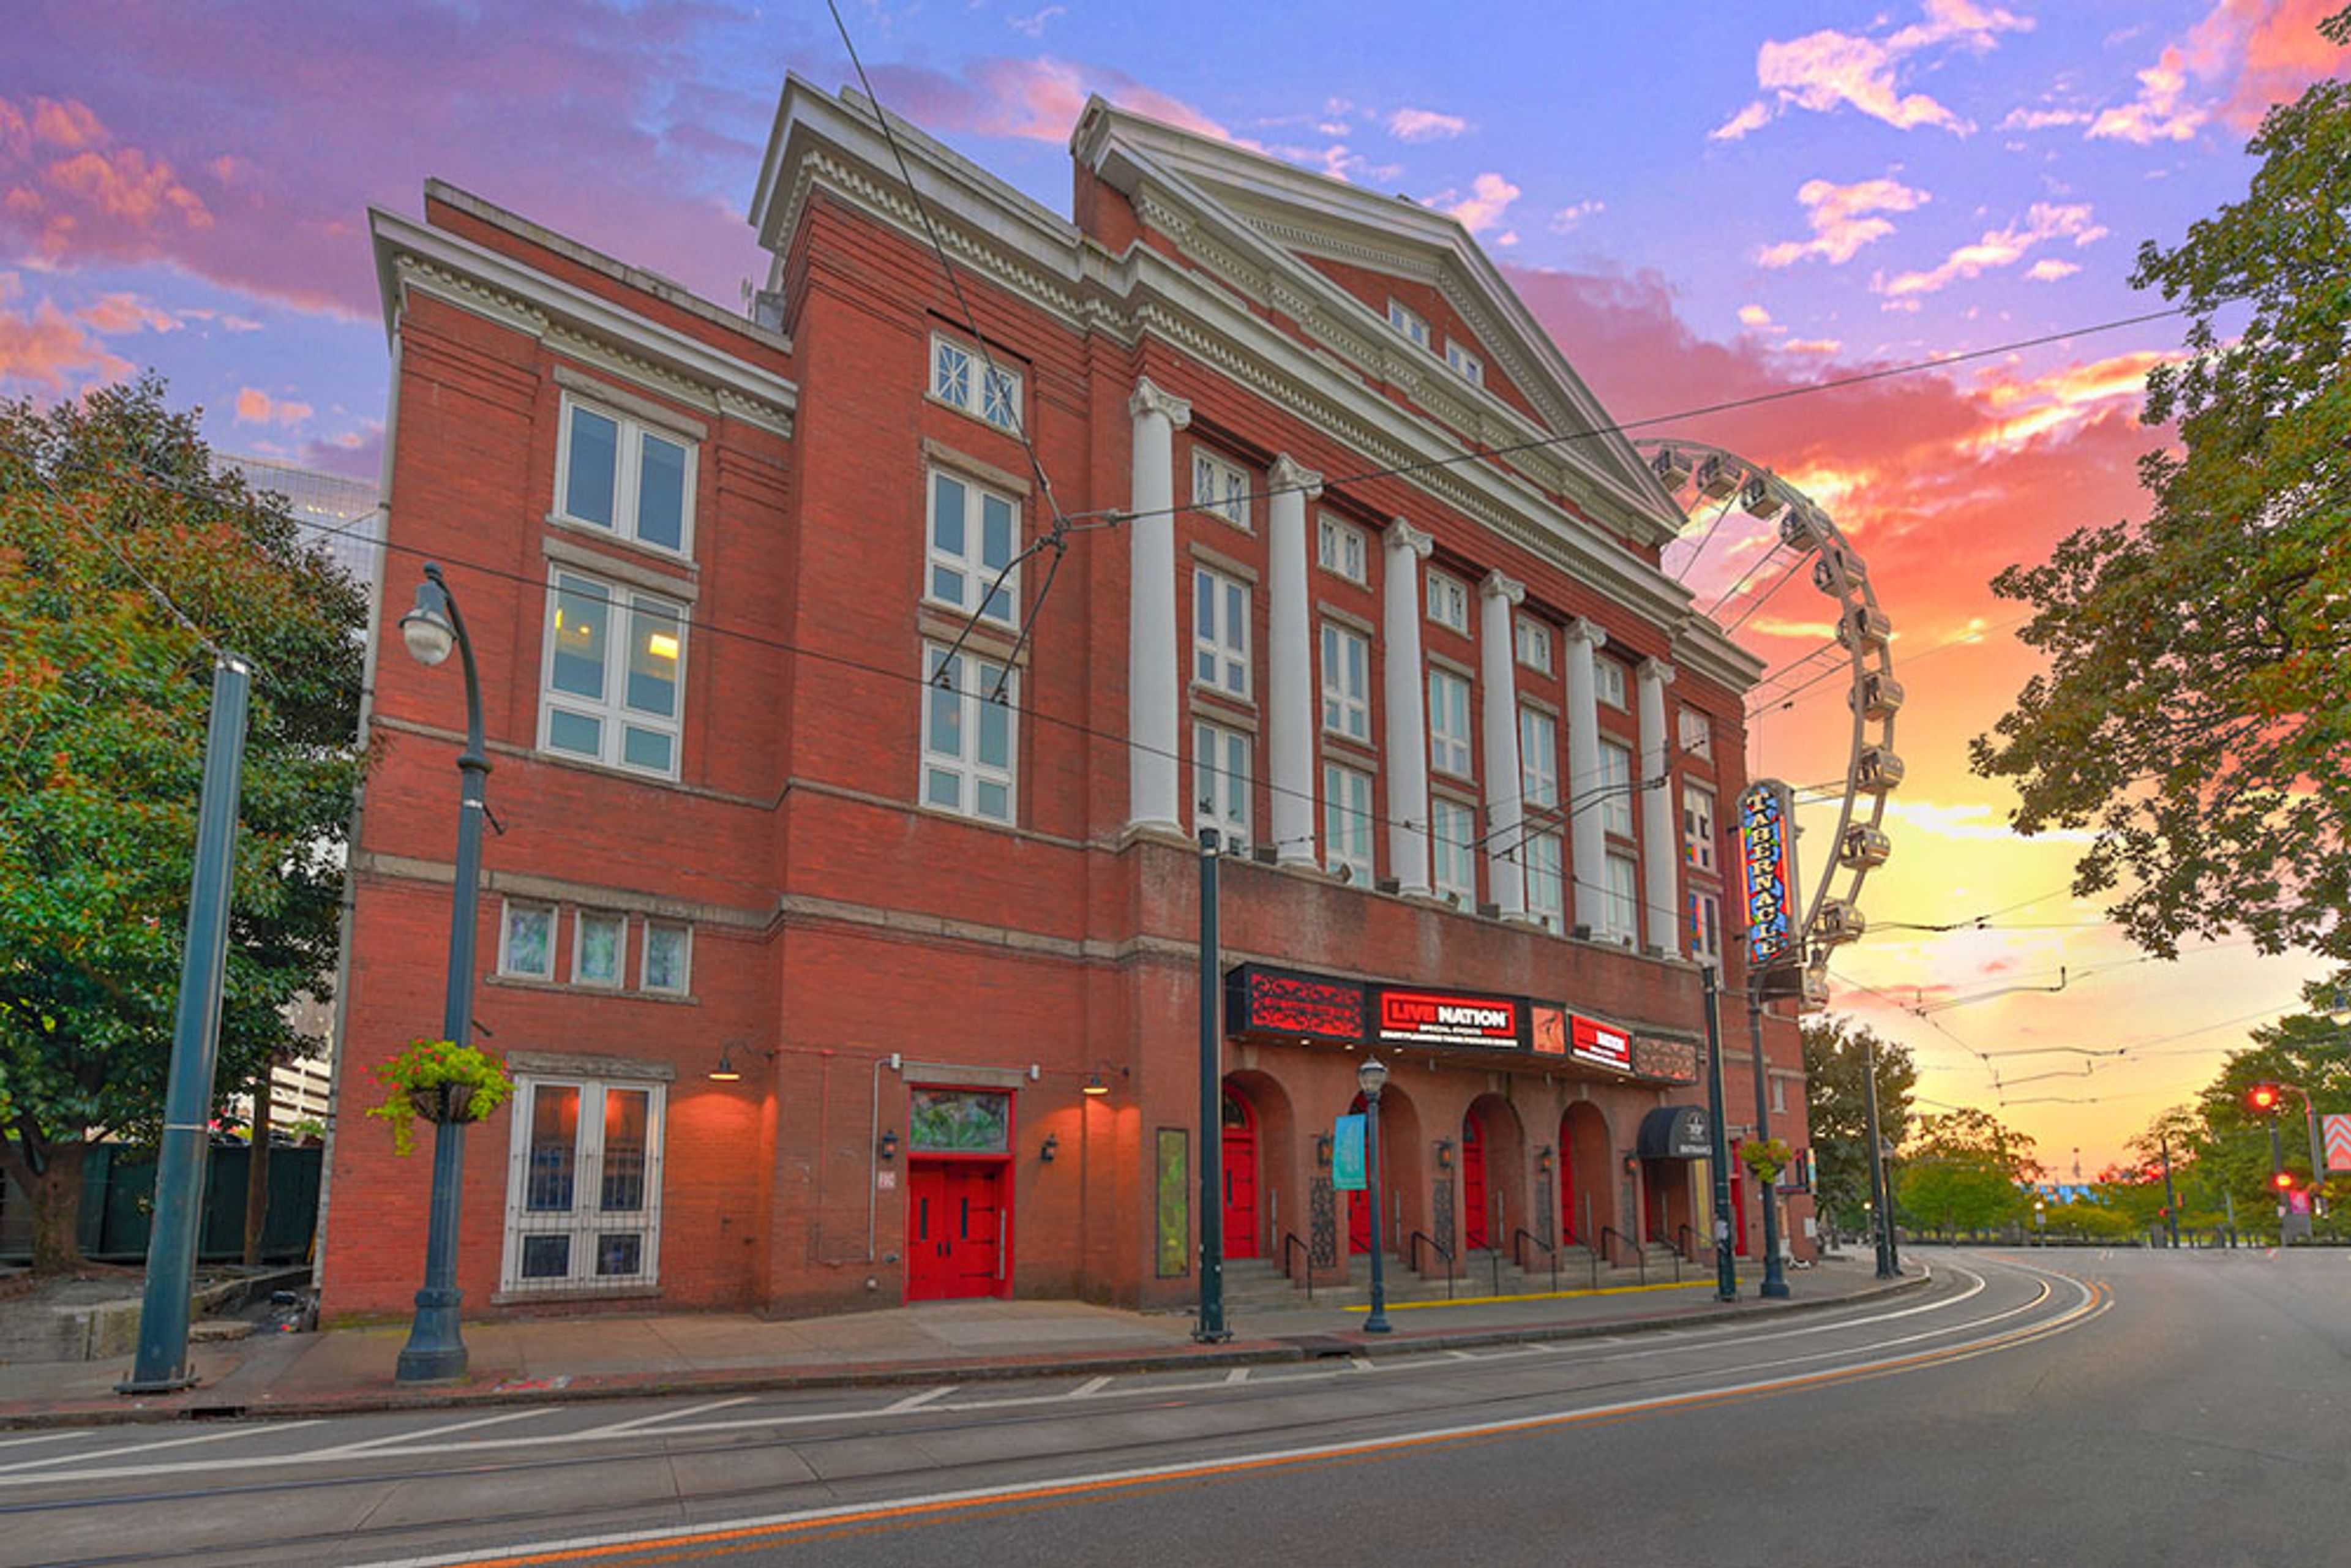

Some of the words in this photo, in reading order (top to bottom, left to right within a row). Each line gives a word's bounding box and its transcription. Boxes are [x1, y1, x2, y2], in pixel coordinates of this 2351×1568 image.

[1746, 793, 1779, 955] TABERNACLE
[1390, 1001, 1436, 1022] LIVE
[1438, 1006, 1507, 1027] NATION
